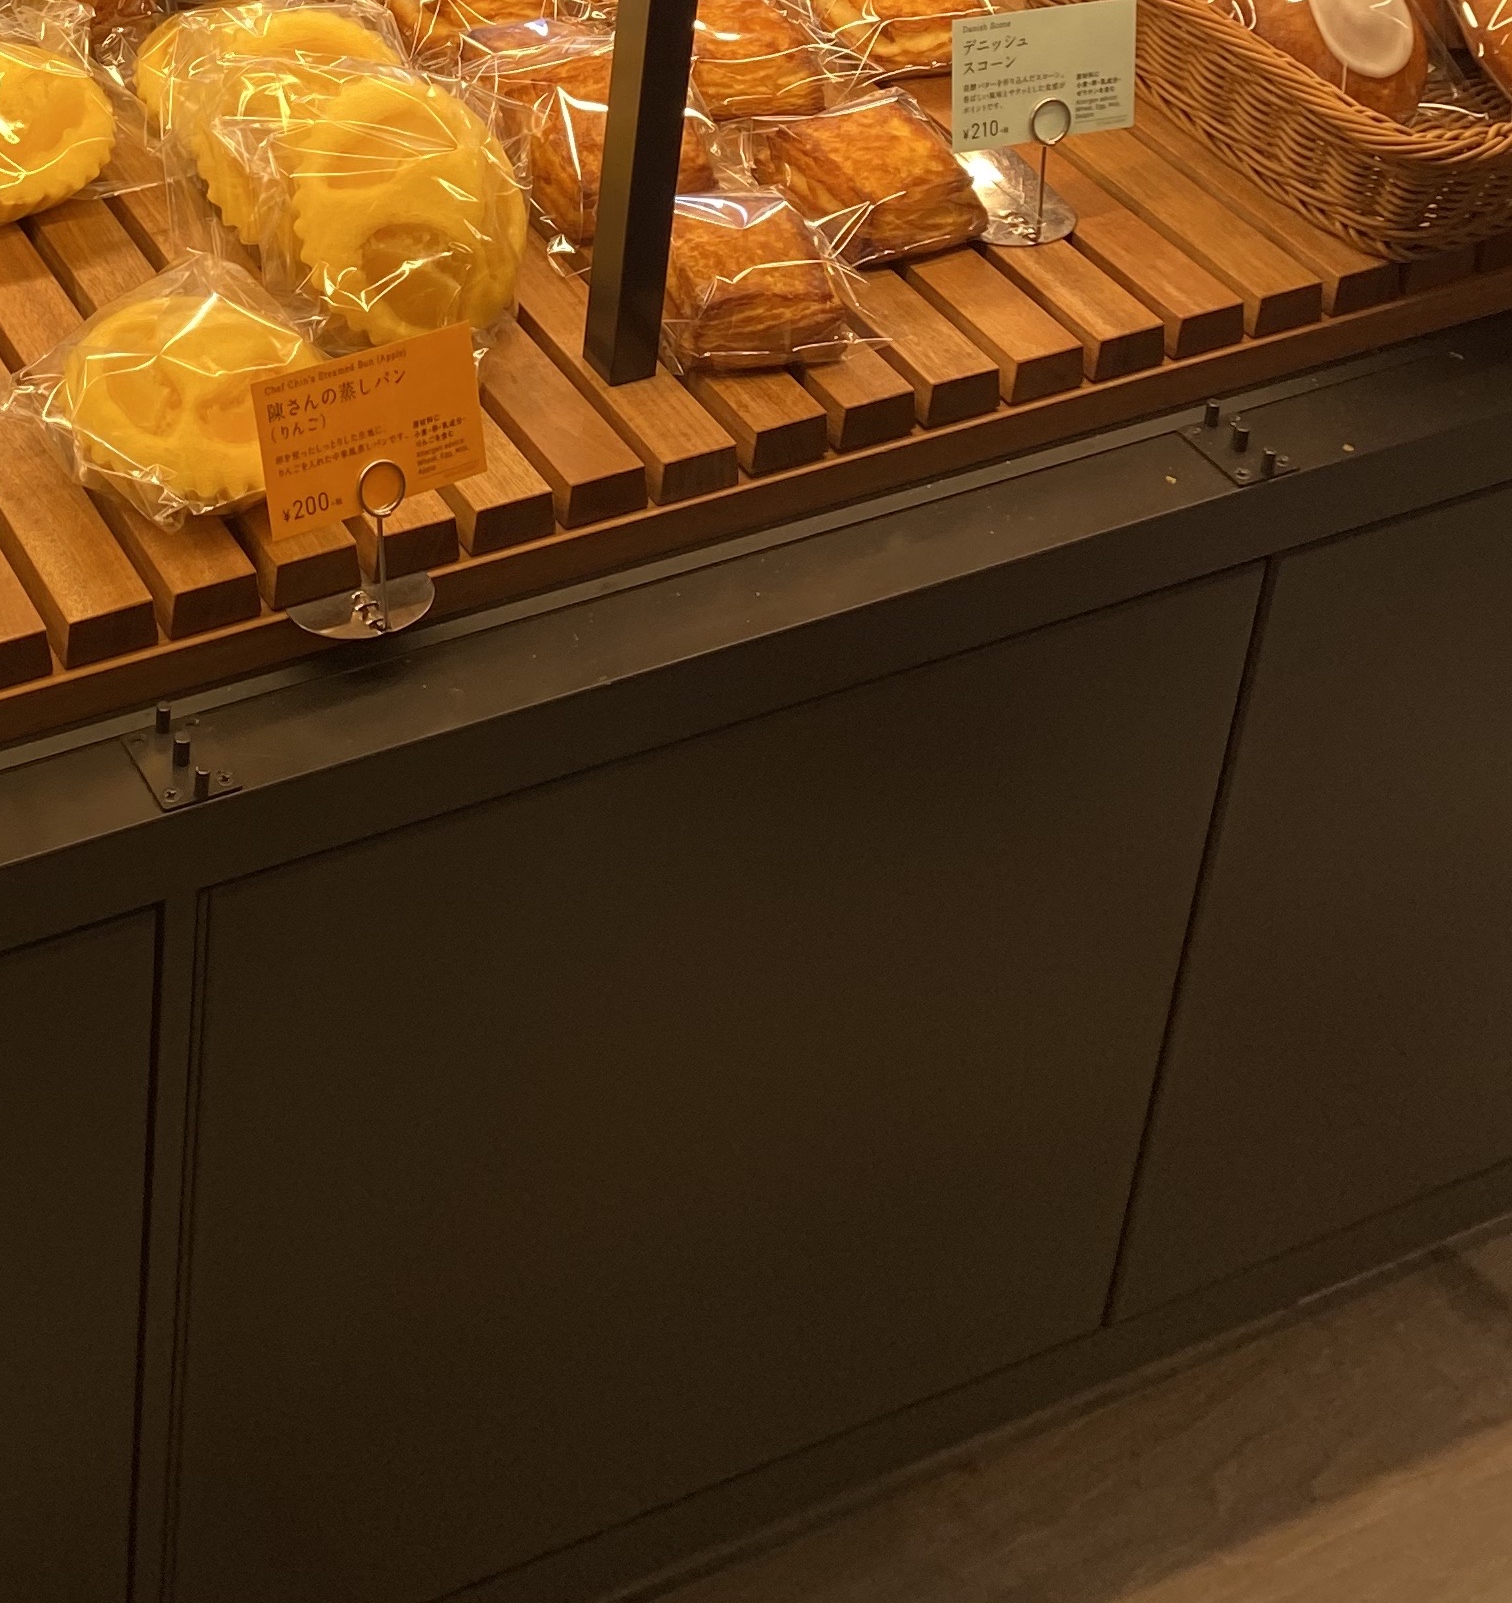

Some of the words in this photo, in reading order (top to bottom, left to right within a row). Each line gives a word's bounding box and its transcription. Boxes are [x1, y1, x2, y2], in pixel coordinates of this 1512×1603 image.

[963, 34, 1028, 55] デニッシュ
[962, 55, 1016, 75] スコーン
[962, 119, 998, 140] ¥210
[265, 368, 406, 425] 陳さんの蒸しパン
[270, 412, 327, 444] （りんご）
[281, 490, 330, 523] ¥200
